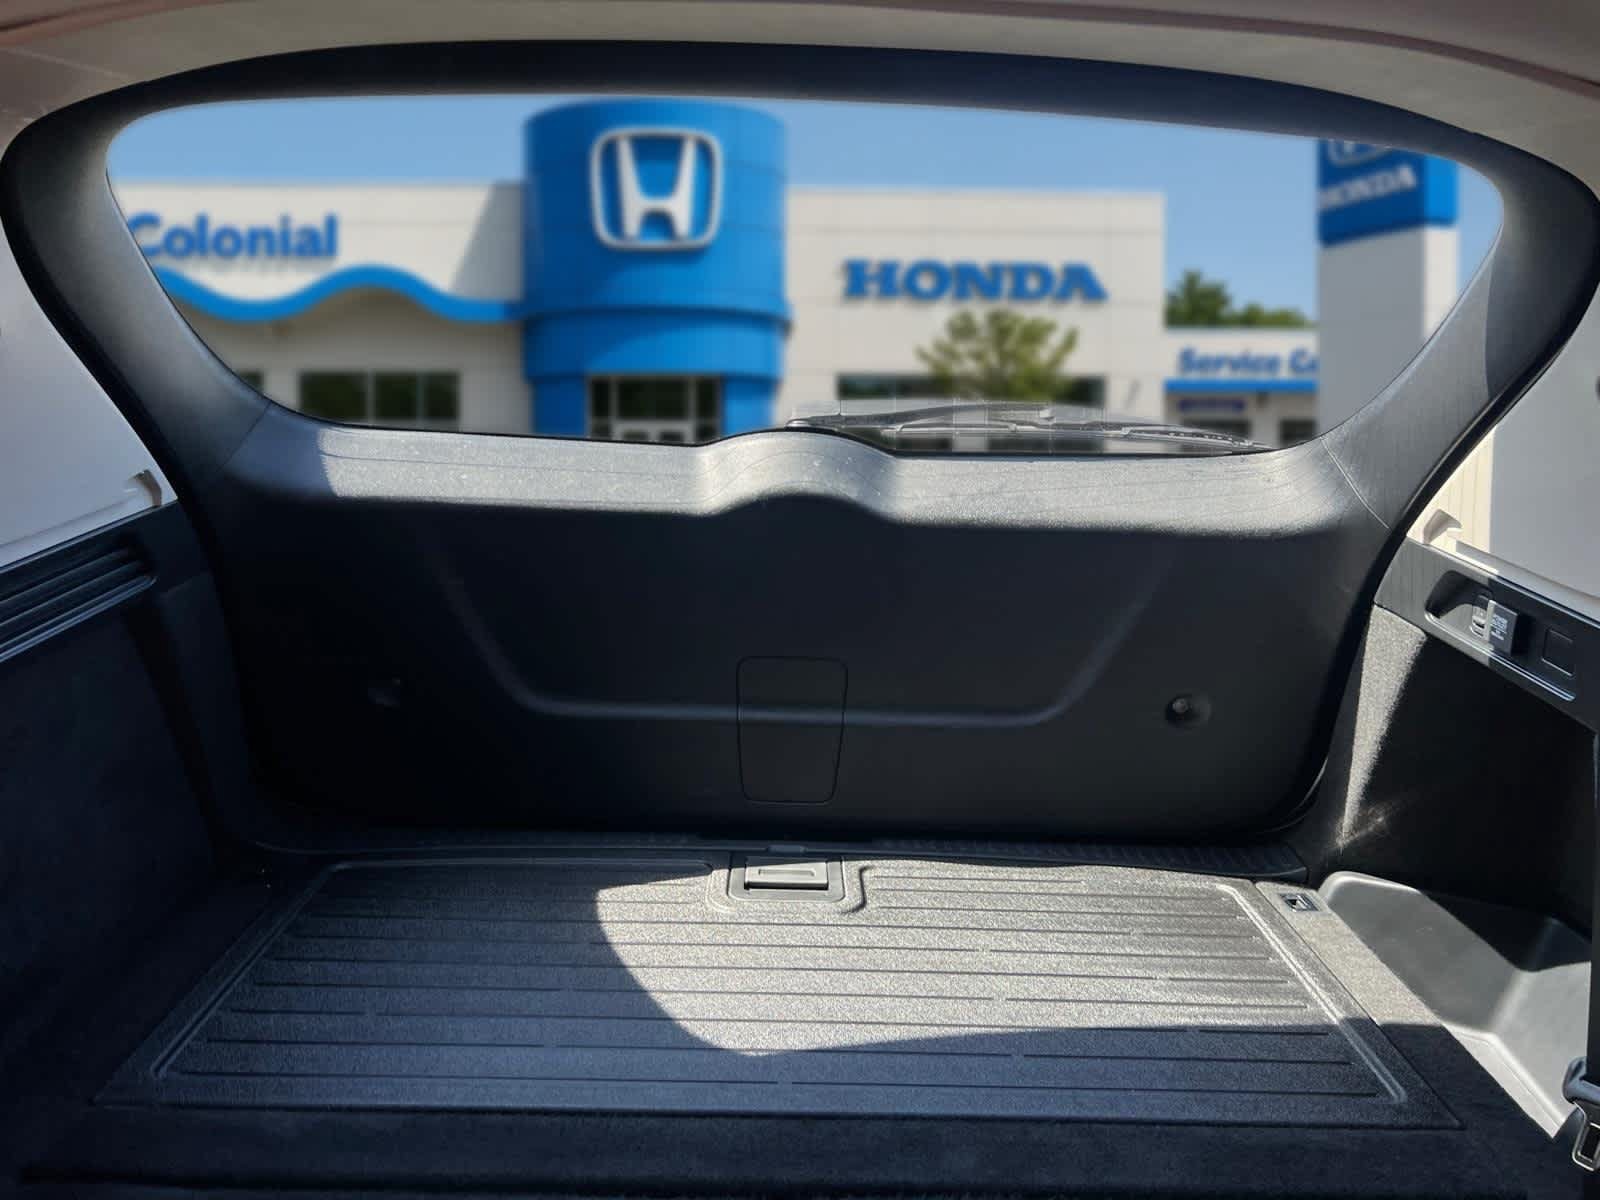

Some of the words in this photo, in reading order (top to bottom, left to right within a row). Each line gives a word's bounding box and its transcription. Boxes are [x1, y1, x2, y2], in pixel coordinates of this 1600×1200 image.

[1316, 164, 1417, 210] HONDA
[128, 212, 338, 259] Colonial
[843, 259, 1107, 301] HONDA
[1179, 348, 1280, 374] Service
